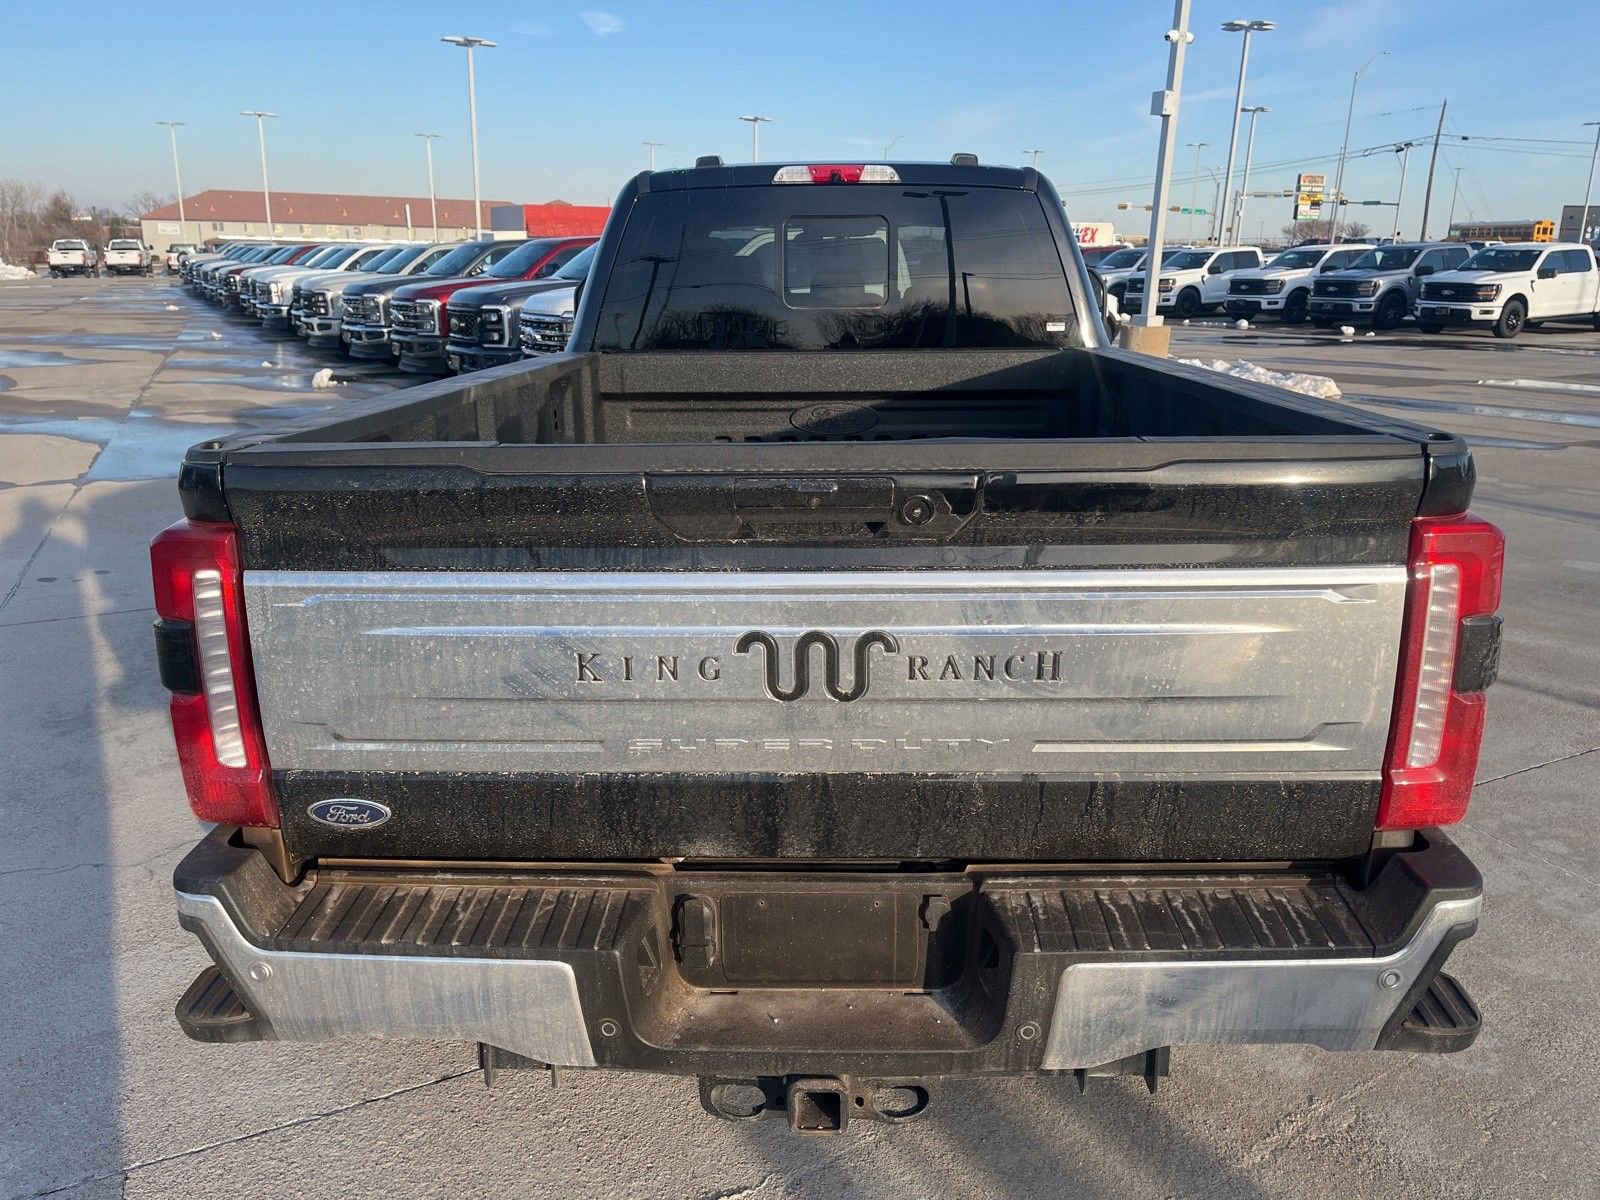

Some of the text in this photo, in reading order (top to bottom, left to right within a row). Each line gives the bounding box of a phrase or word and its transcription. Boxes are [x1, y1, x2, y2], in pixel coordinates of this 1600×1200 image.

[574, 650, 1063, 683] KING RANCH
[325, 804, 371, 823] Ford
